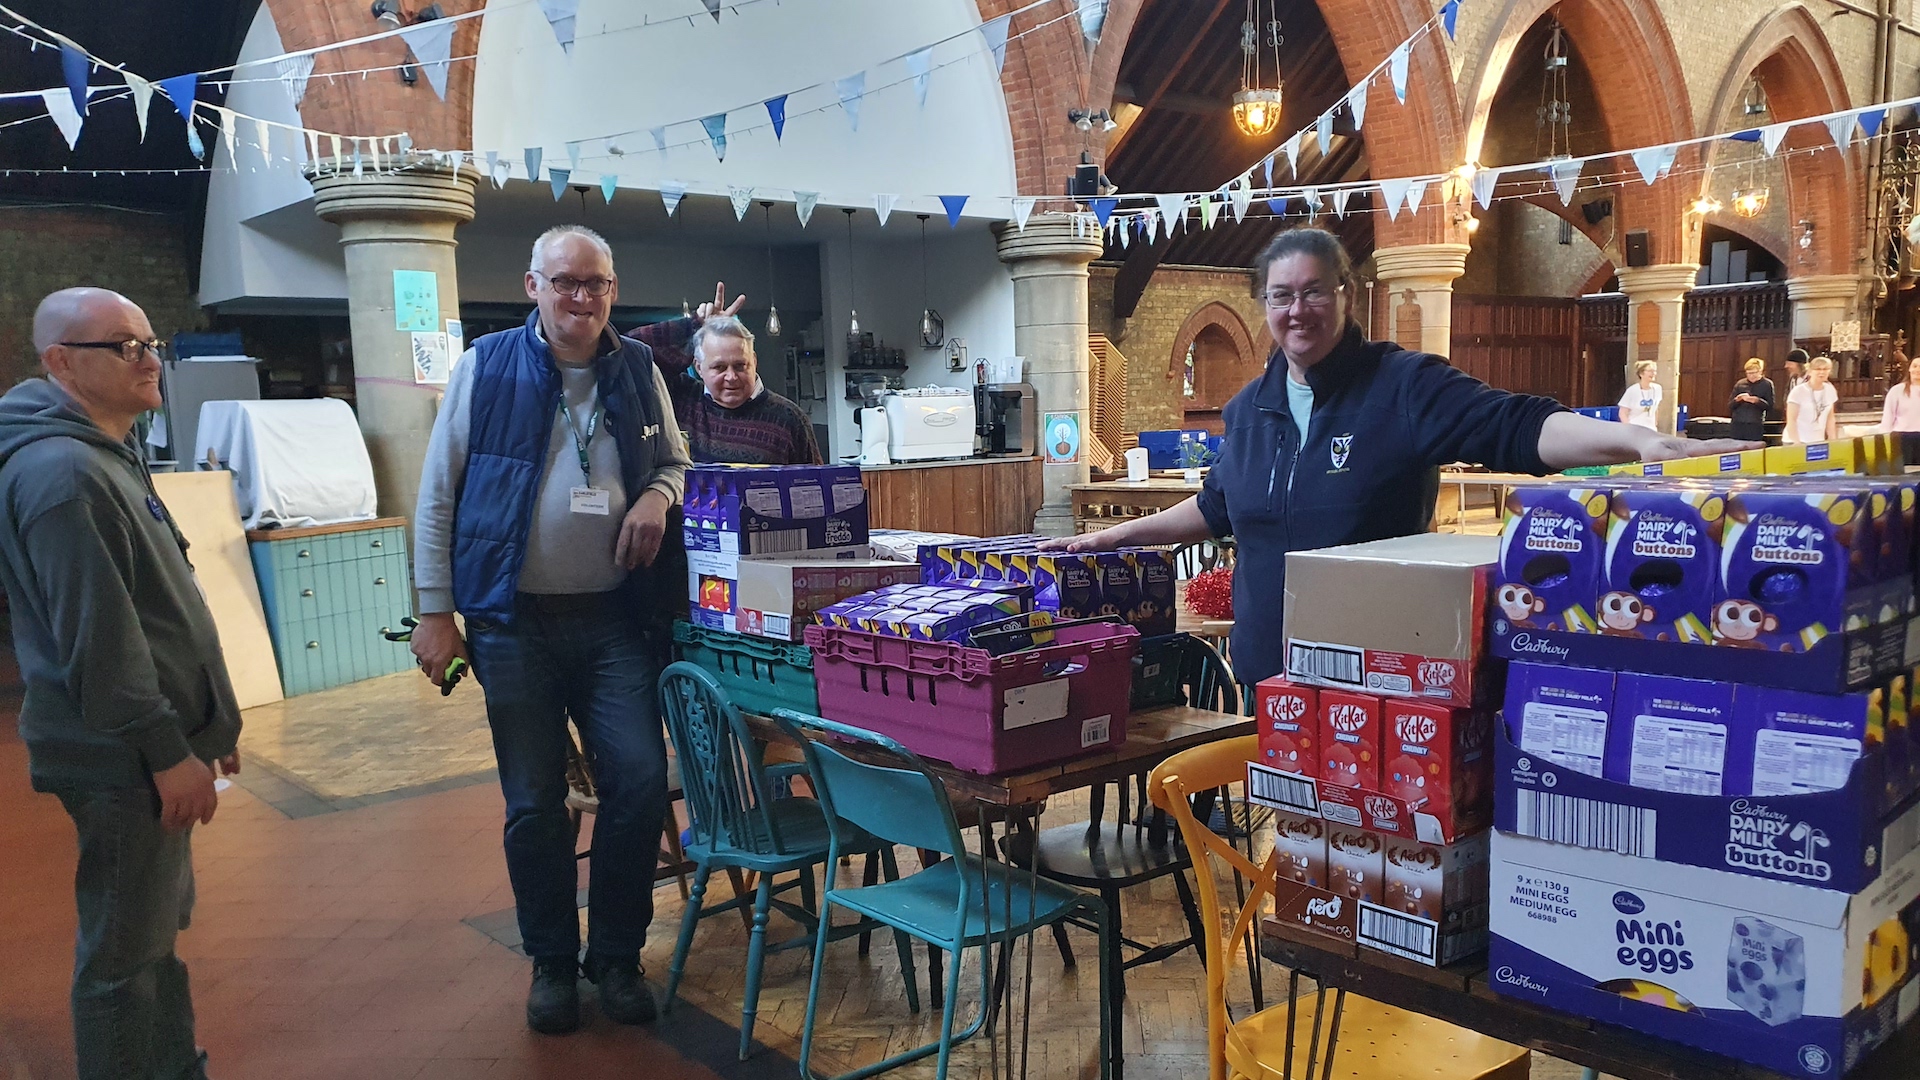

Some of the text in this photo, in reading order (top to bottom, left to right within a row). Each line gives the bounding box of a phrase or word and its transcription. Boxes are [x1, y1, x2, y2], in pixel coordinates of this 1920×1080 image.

[1529, 527, 1555, 537] MILK
[1530, 517, 1563, 528] DAIRY
[1637, 521, 1675, 532] DAIRY
[1757, 525, 1799, 537] DAIRY
[825, 531, 852, 545] Freddo
[1526, 536, 1582, 552] buttons
[1636, 531, 1665, 541] MILK
[1756, 535, 1788, 547] MILK
[1633, 541, 1695, 557] buttons
[1752, 546, 1821, 563] buttons
[1511, 632, 1570, 660] Cadbury
[1420, 662, 1455, 686] KitKat
[1270, 695, 1305, 720] KitKat
[1332, 706, 1366, 731] KitKat
[1398, 716, 1436, 742] KitKat
[1367, 797, 1397, 818] KitKat
[1730, 798, 1788, 823] Cadbury
[1729, 814, 1791, 836] DAIRY
[1729, 829, 1778, 850] MILK
[1726, 844, 1830, 880] buttons
[1515, 885, 1570, 905] MINI EGGS
[1517, 874, 1523, 883] 9
[1544, 880, 1561, 891] 130
[1562, 886, 1570, 895] g
[1306, 895, 1343, 920] Aero
[1509, 895, 1578, 919] MEDIUM EGG
[1614, 895, 1644, 911] Cadbury
[1527, 910, 1558, 924] 668988
[1616, 919, 1685, 946] Mini
[1742, 937, 1766, 951] Mini
[1616, 946, 1695, 975] eggs
[1741, 948, 1767, 962] eggs
[1495, 966, 1549, 997] Cadbury
